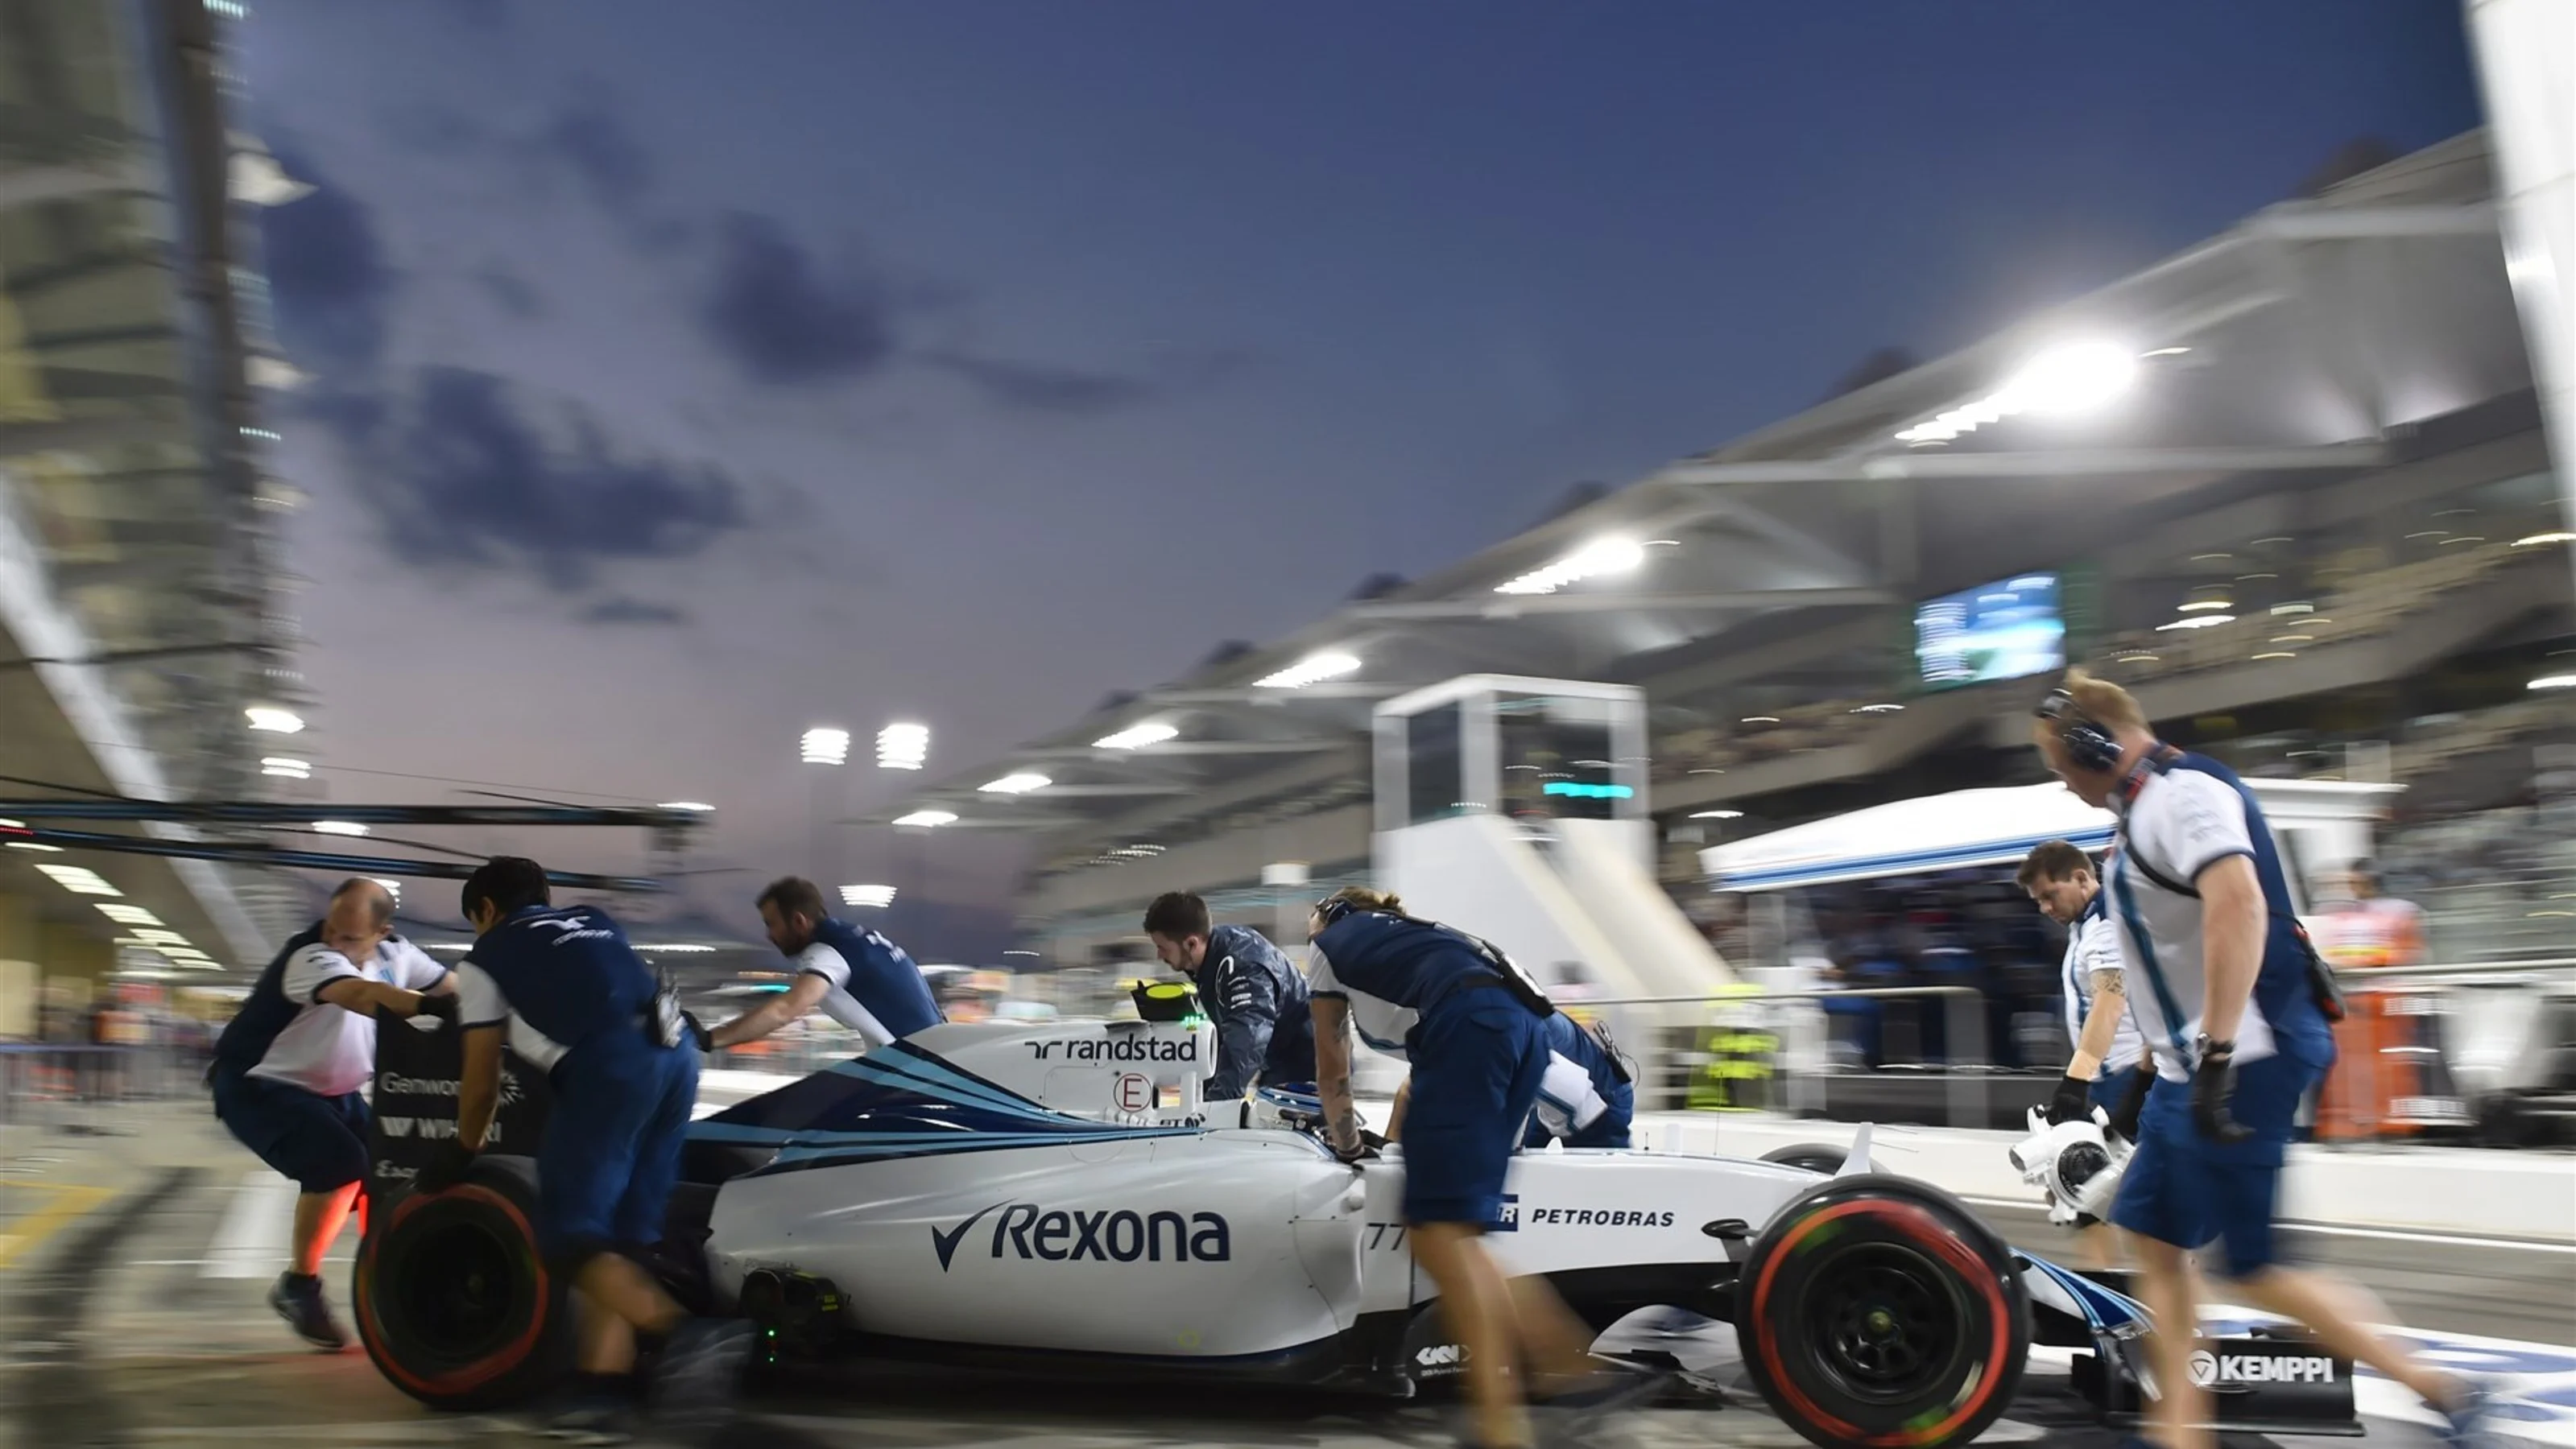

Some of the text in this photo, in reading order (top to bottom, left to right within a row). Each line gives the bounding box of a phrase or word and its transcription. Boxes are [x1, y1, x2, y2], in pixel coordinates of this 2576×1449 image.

[1067, 1033, 1197, 1061] randstad
[1123, 1078, 1143, 1108] E
[1532, 1208, 1674, 1227] PETROBRAS
[991, 1203, 1230, 1261] Rexona
[2219, 1355, 2334, 1383] KEMPPI
